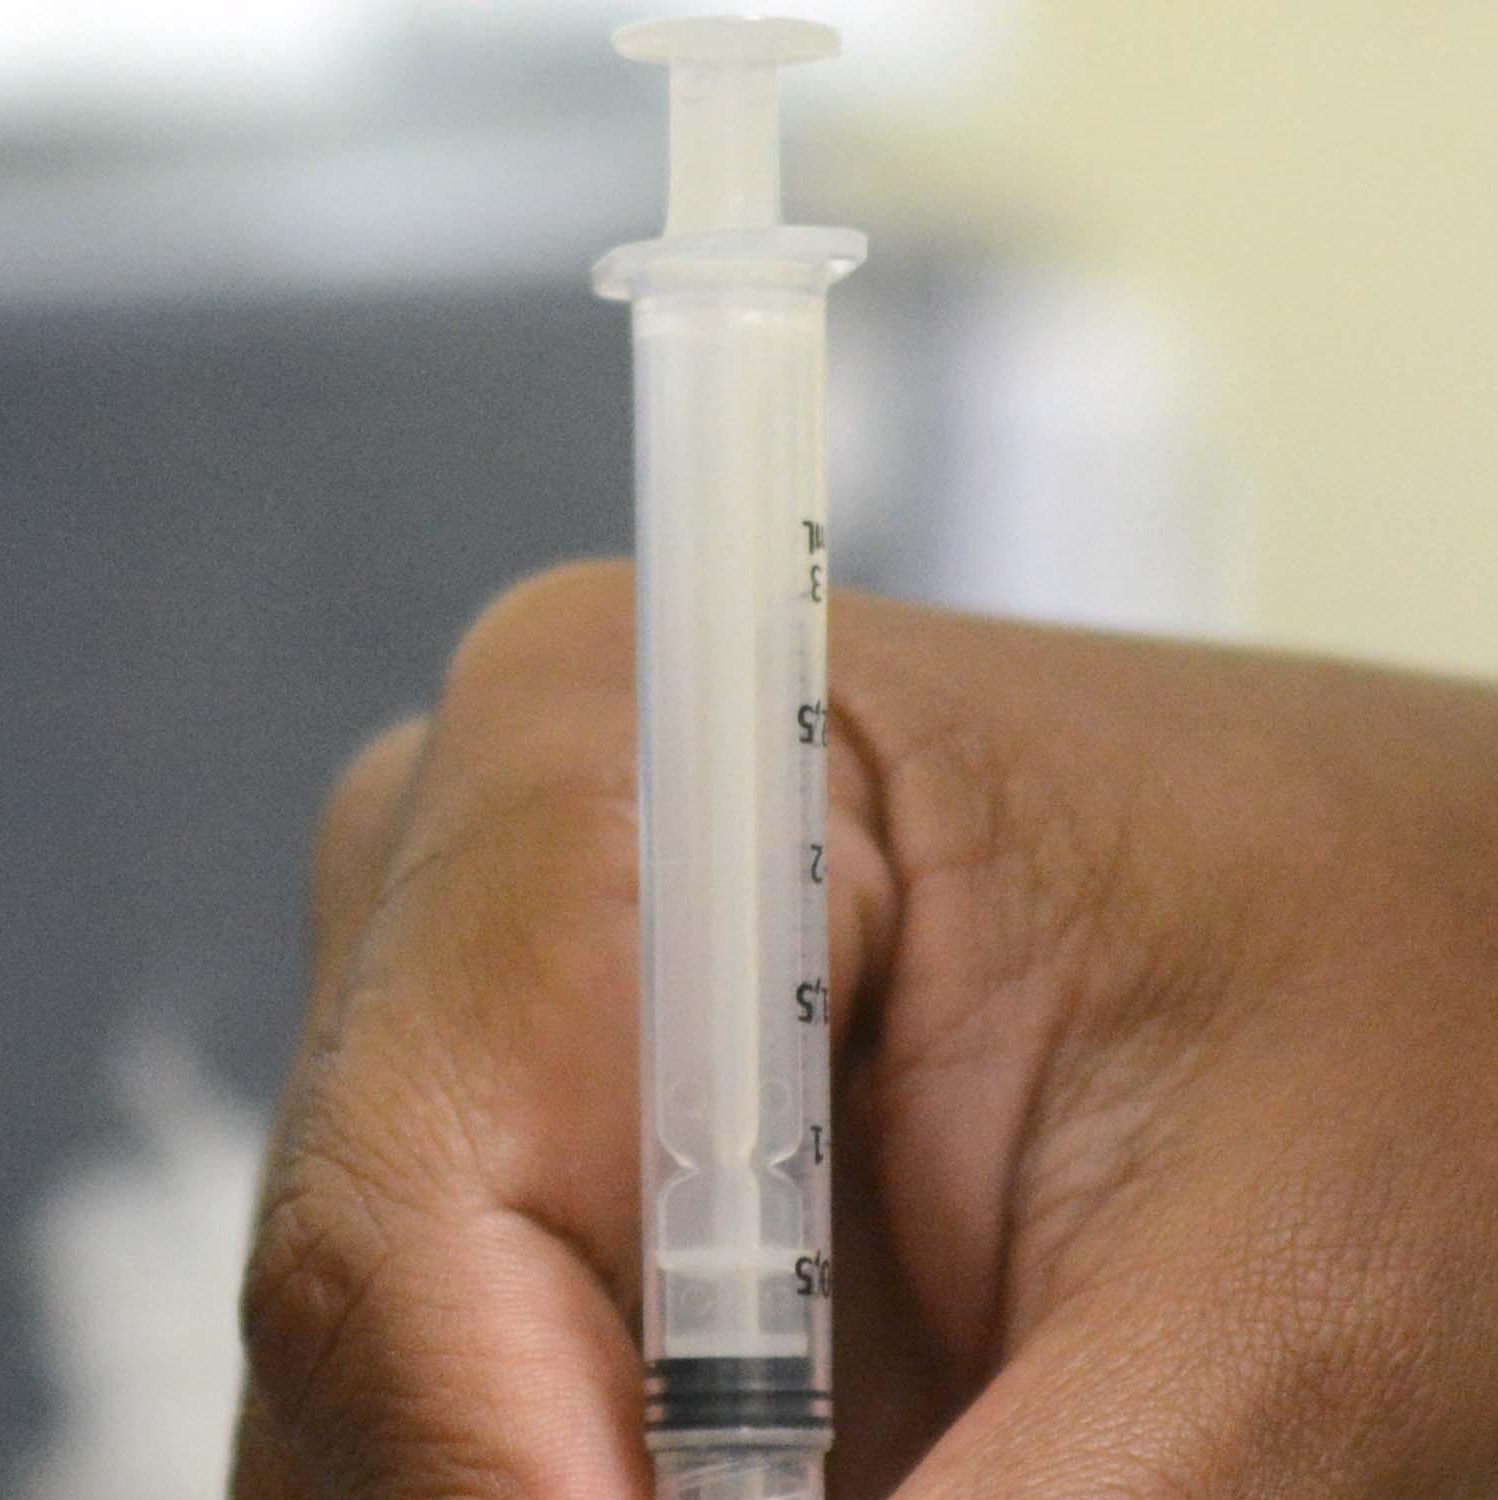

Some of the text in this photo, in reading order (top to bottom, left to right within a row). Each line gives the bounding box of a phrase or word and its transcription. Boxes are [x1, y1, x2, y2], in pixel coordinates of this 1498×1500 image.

[809, 565, 823, 603] 3
[810, 843, 823, 884] 2
[810, 1124, 824, 1167] 1
